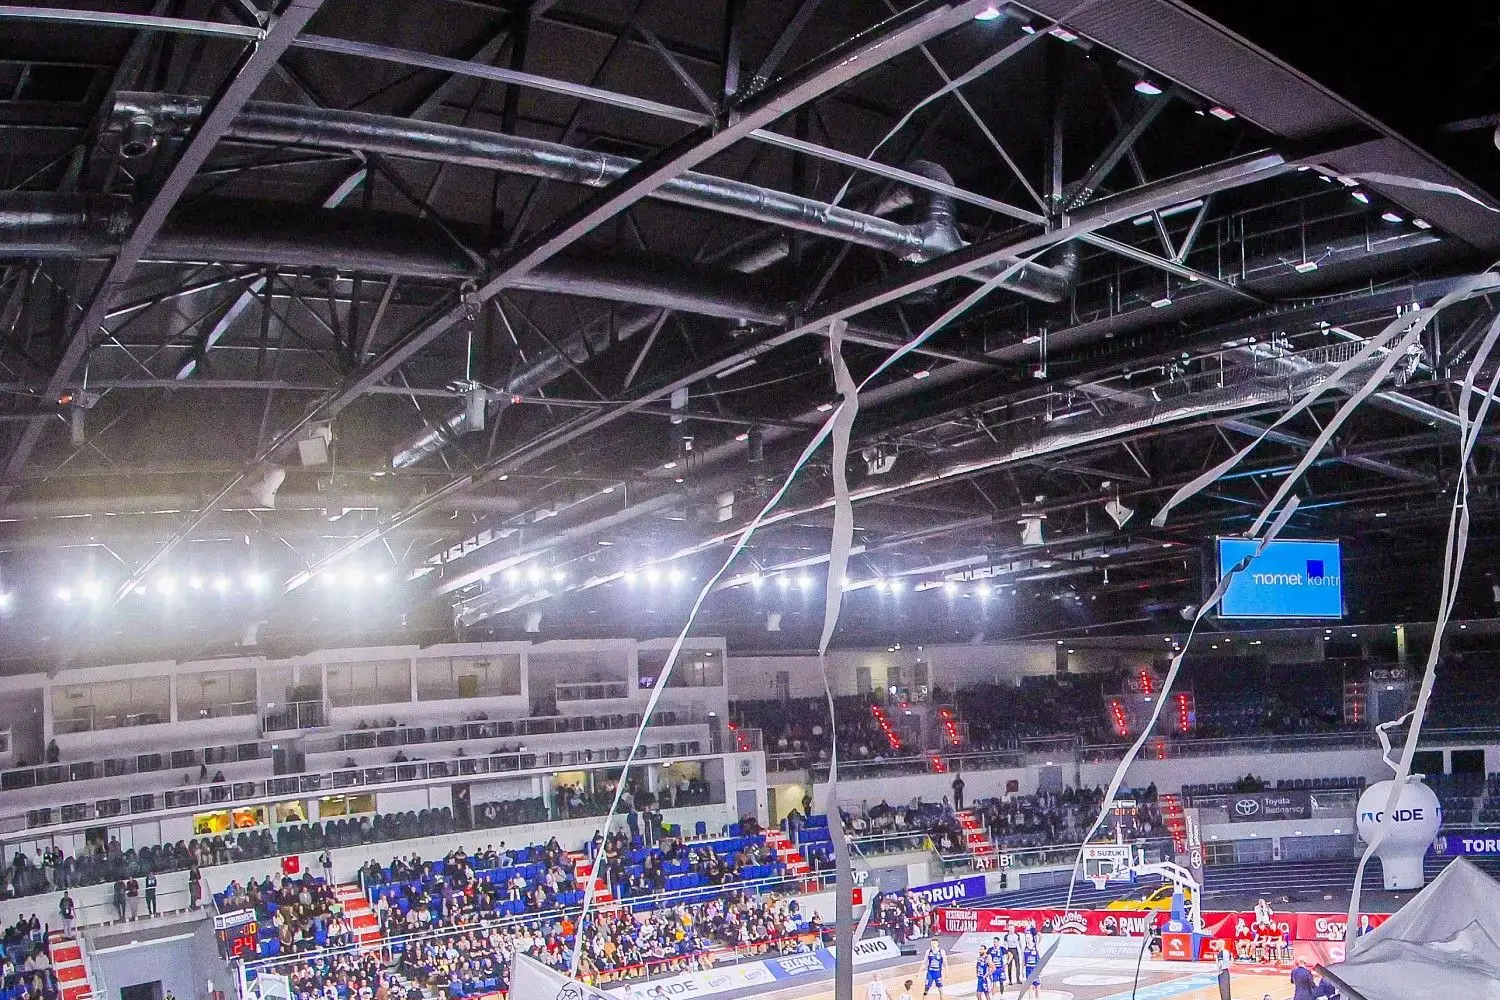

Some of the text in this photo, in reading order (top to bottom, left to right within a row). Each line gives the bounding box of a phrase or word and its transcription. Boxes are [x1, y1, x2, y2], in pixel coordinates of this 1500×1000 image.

[1265, 797, 1290, 807] Toyota
[946, 920, 978, 932] LUIZJANA
[233, 936, 254, 956] 24
